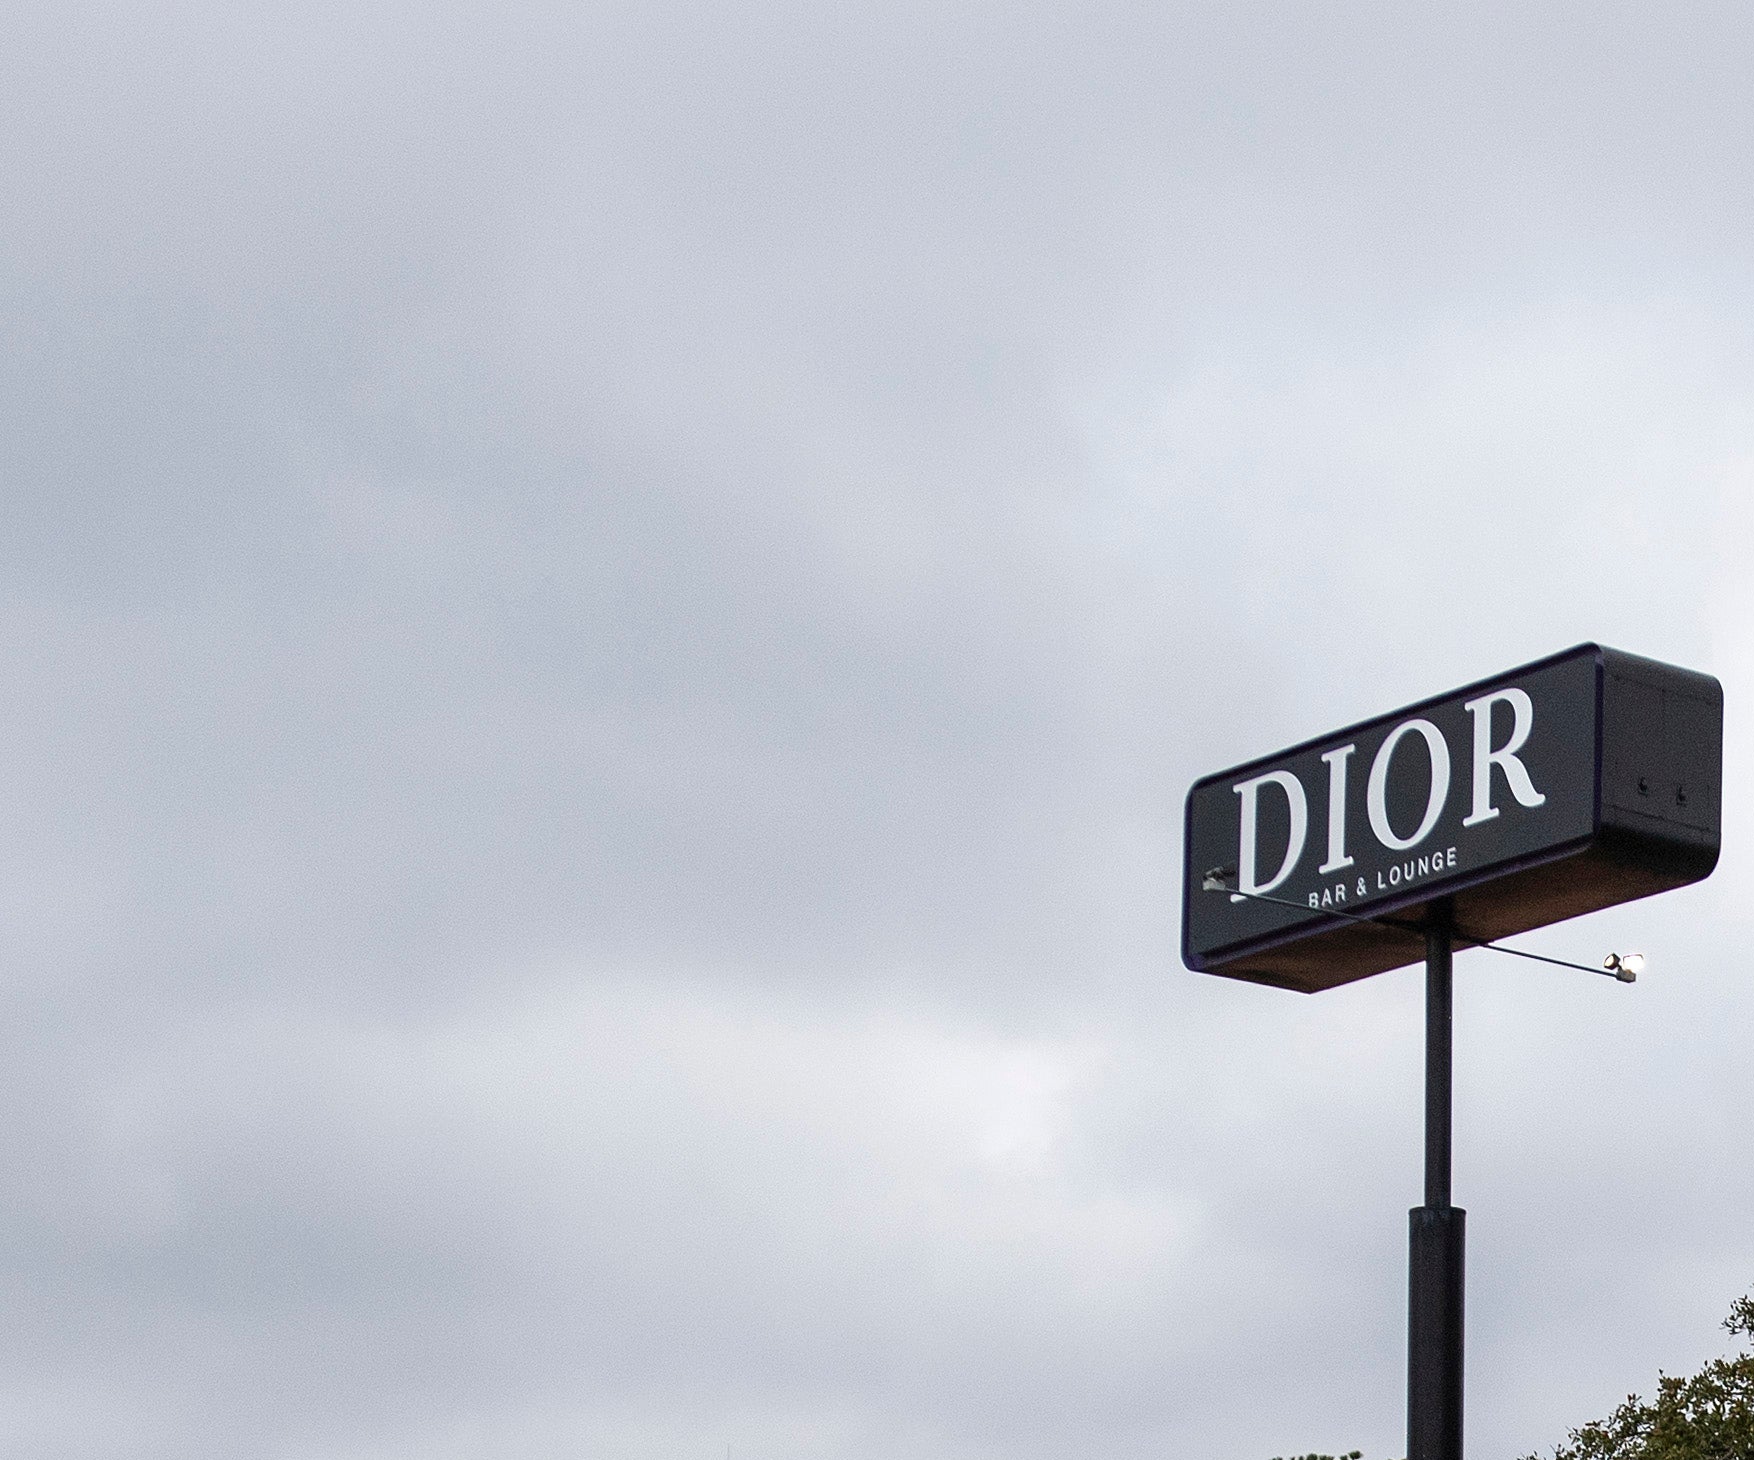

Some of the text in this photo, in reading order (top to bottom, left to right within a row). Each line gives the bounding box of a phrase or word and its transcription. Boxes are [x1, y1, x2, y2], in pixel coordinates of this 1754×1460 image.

[1230, 686, 1546, 904] DIOR
[1308, 846, 1458, 909] BAR & LOUNGE
